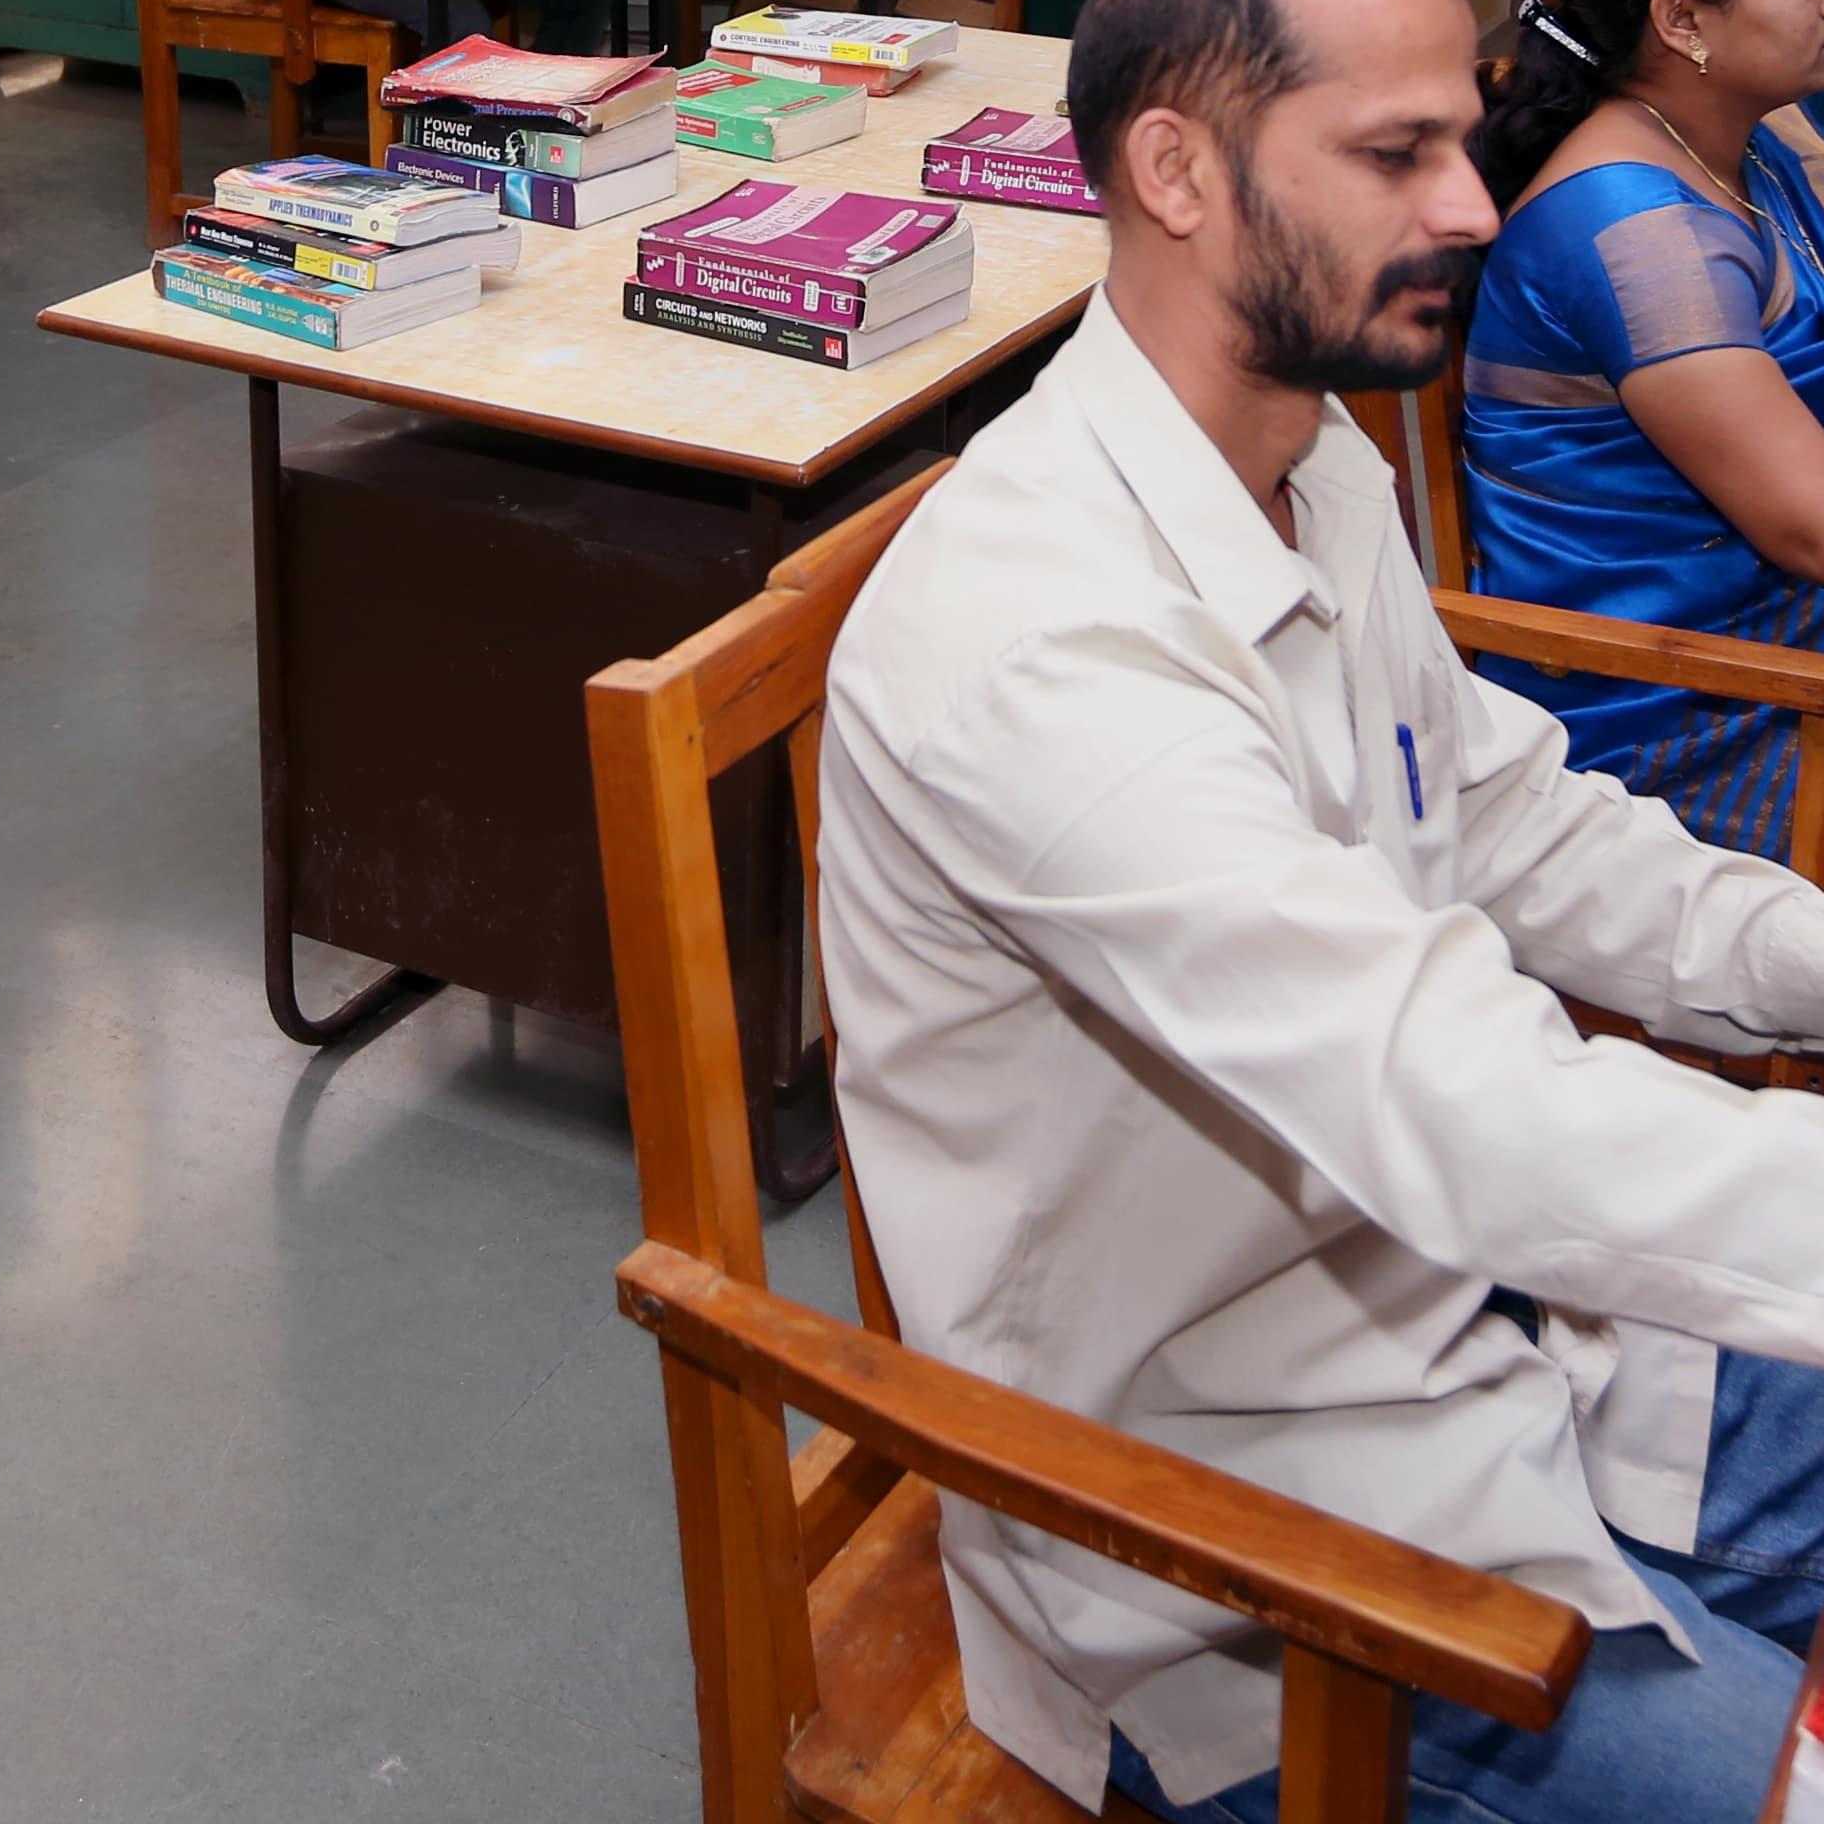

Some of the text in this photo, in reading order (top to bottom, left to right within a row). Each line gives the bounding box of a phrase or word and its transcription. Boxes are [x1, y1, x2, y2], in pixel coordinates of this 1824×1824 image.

[760, 36, 800, 47] ENGINEERING
[424, 116, 472, 137] Power
[422, 130, 501, 162] Electronics
[397, 161, 465, 185] Electronic Devices
[984, 157, 1073, 178] Fundamentals of
[981, 169, 1073, 195] Digital Circuits
[269, 198, 353, 228] APPLIED THERMODYNAMICS
[699, 257, 791, 284] Fundamentals of
[166, 276, 263, 316] THERMAL ENGINEERING
[696, 268, 742, 295] Digital
[742, 279, 792, 304] Circuits
[656, 297, 768, 334] CIRCUITS AND NETWORKS
[657, 309, 763, 343] ANALYSIS AND SYNTHESIS
